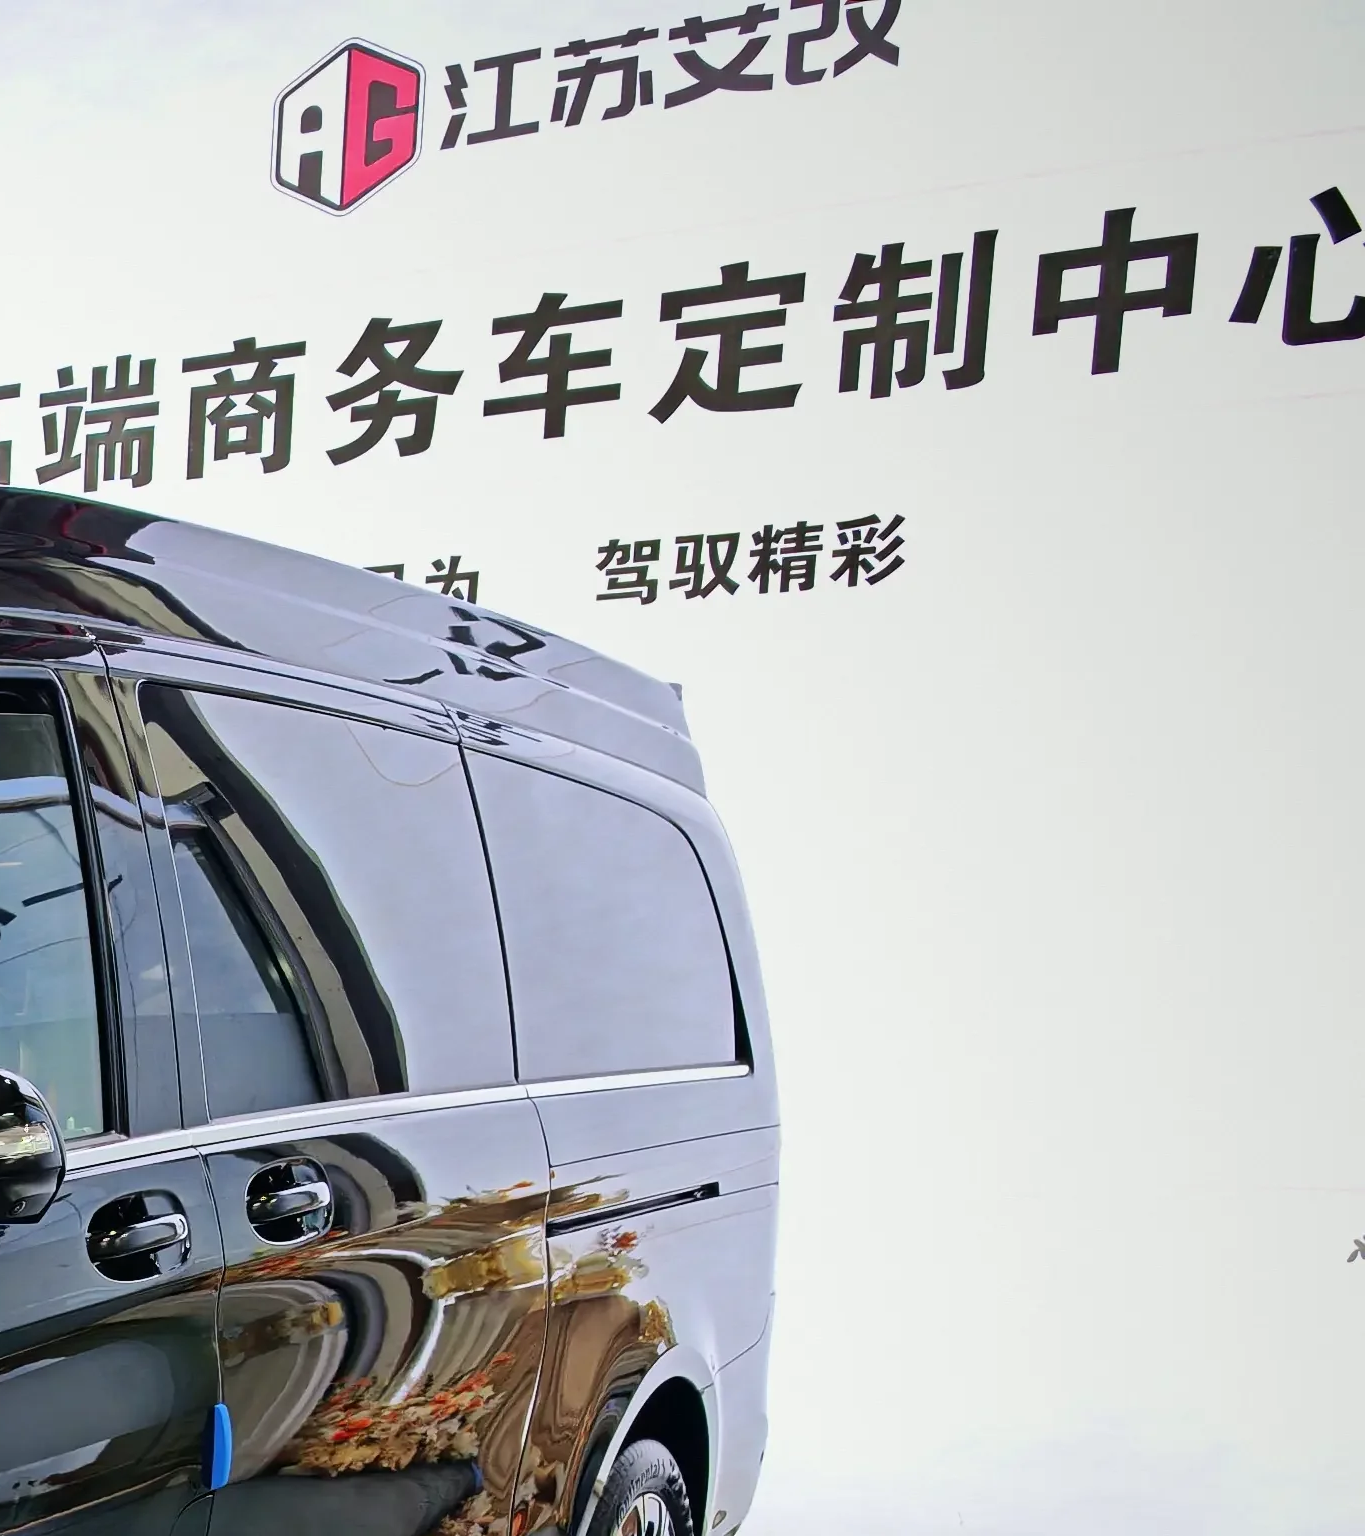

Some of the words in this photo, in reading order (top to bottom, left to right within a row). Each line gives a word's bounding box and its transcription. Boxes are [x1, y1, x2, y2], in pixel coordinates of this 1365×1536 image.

[440, 0, 902, 150] 江苏艾改
[364, 556, 480, 605] 为
[596, 514, 906, 605] 驾驭精彩
